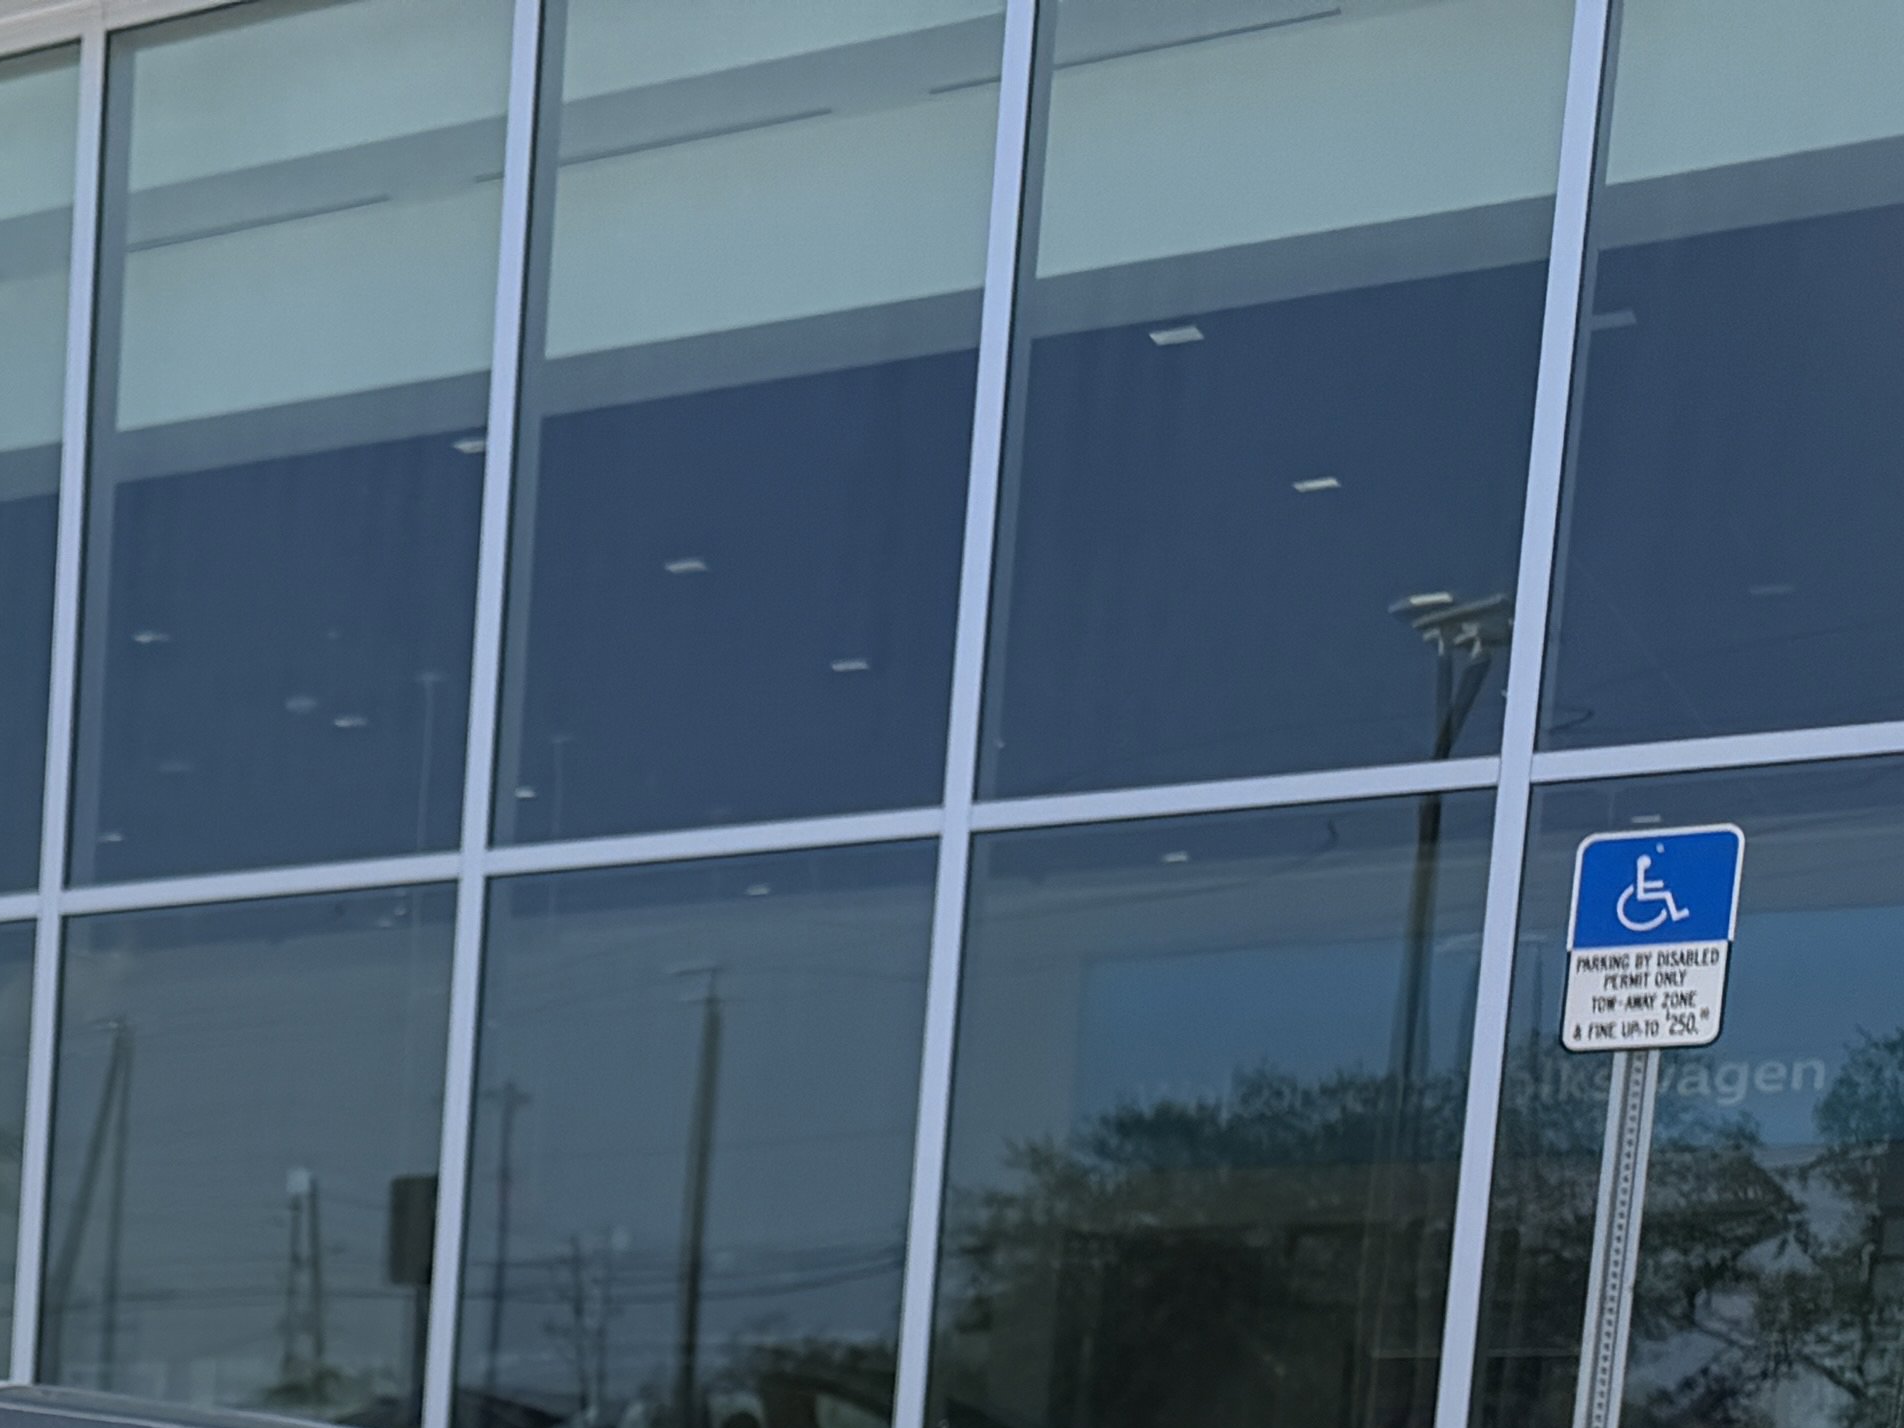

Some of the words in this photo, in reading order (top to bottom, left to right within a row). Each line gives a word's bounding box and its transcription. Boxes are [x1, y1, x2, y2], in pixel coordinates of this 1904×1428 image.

[1576, 953, 1629, 974] PARKING
[1634, 952, 1652, 969] BY
[1657, 947, 1720, 967] DISABLED
[1603, 972, 1649, 990] PERMIT
[1654, 969, 1687, 987] ONLY
[1662, 991, 1697, 1008] ZONE
[1588, 1022, 1616, 1040] FINE
